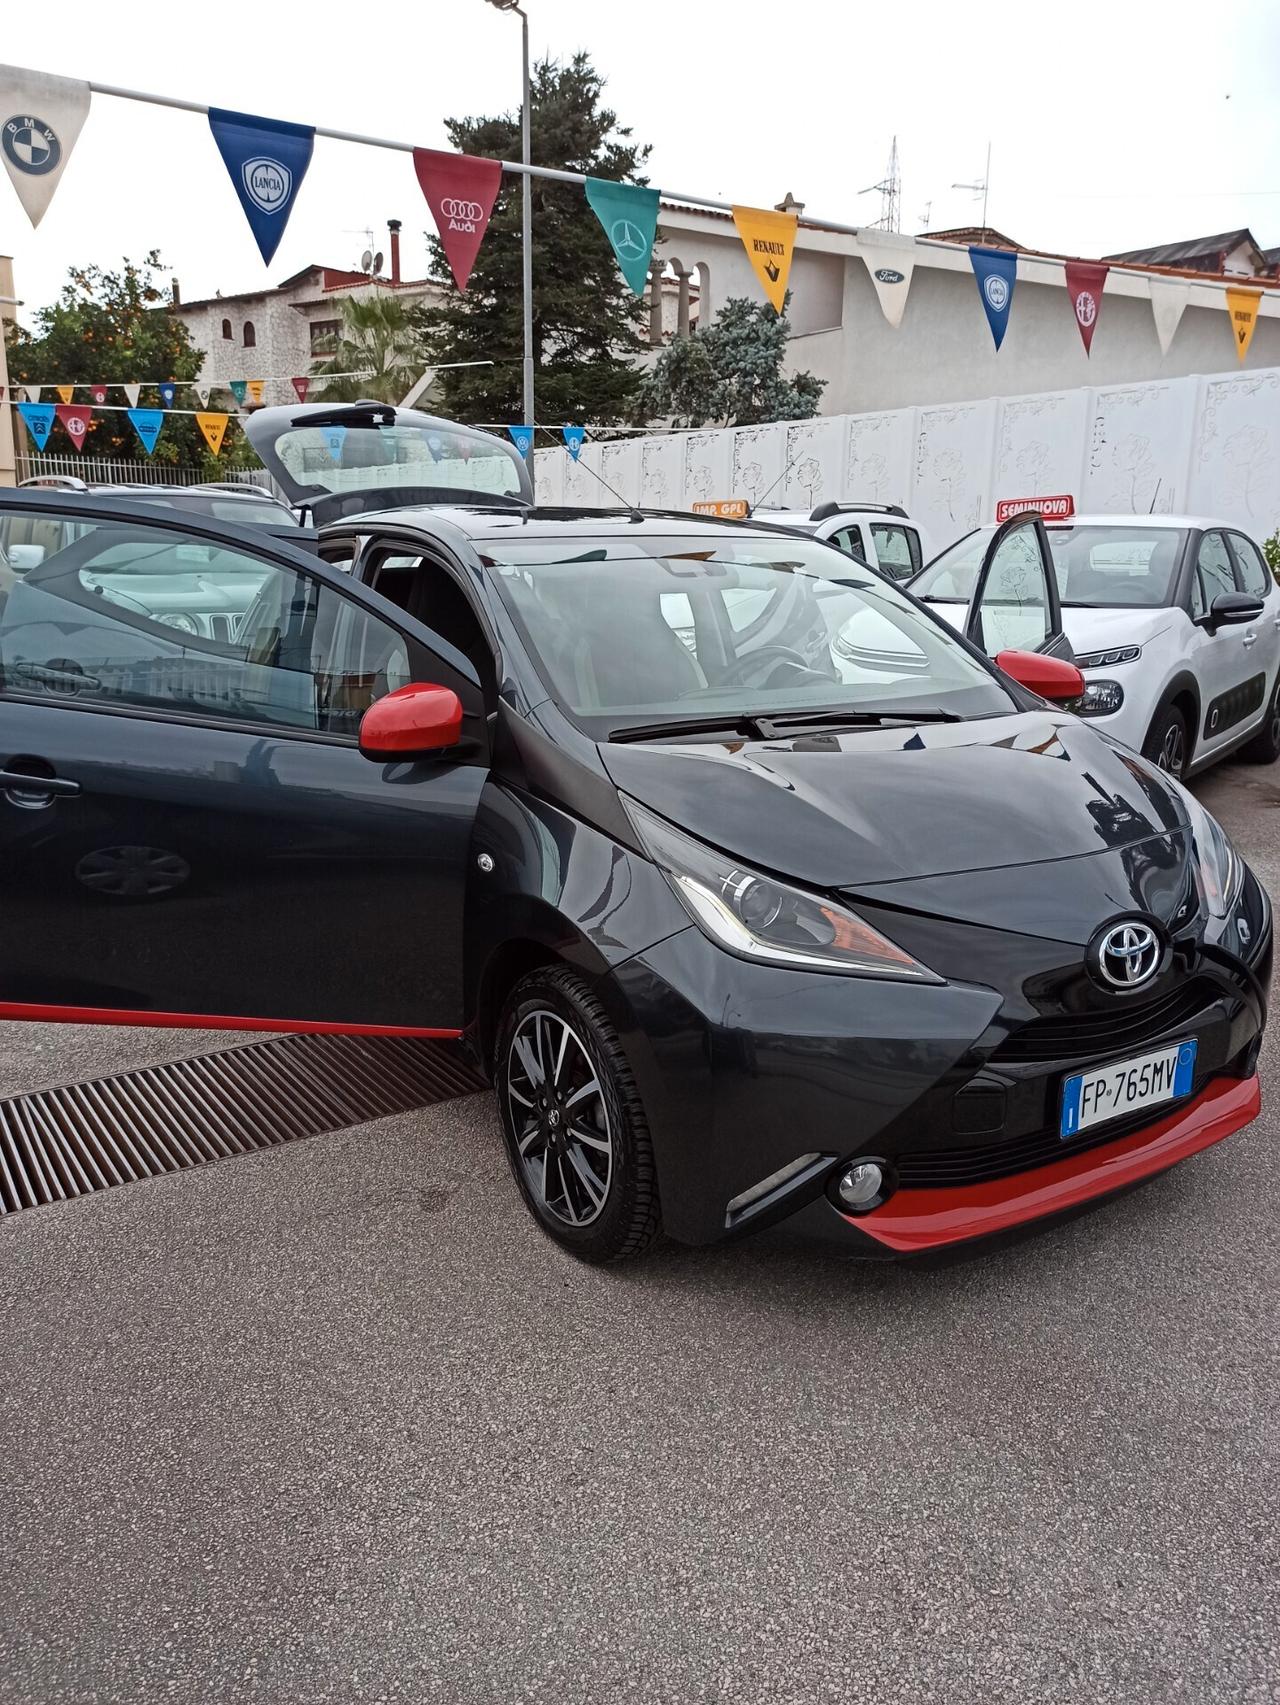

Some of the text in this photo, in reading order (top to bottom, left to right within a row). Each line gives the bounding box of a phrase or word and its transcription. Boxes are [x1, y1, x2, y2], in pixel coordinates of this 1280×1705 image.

[7, 118, 56, 141] BMW
[255, 176, 281, 191] LANCIA
[448, 218, 476, 233] Audi
[753, 239, 785, 256] RENAULT
[879, 270, 899, 281] Ford
[721, 503, 742, 515] GPL
